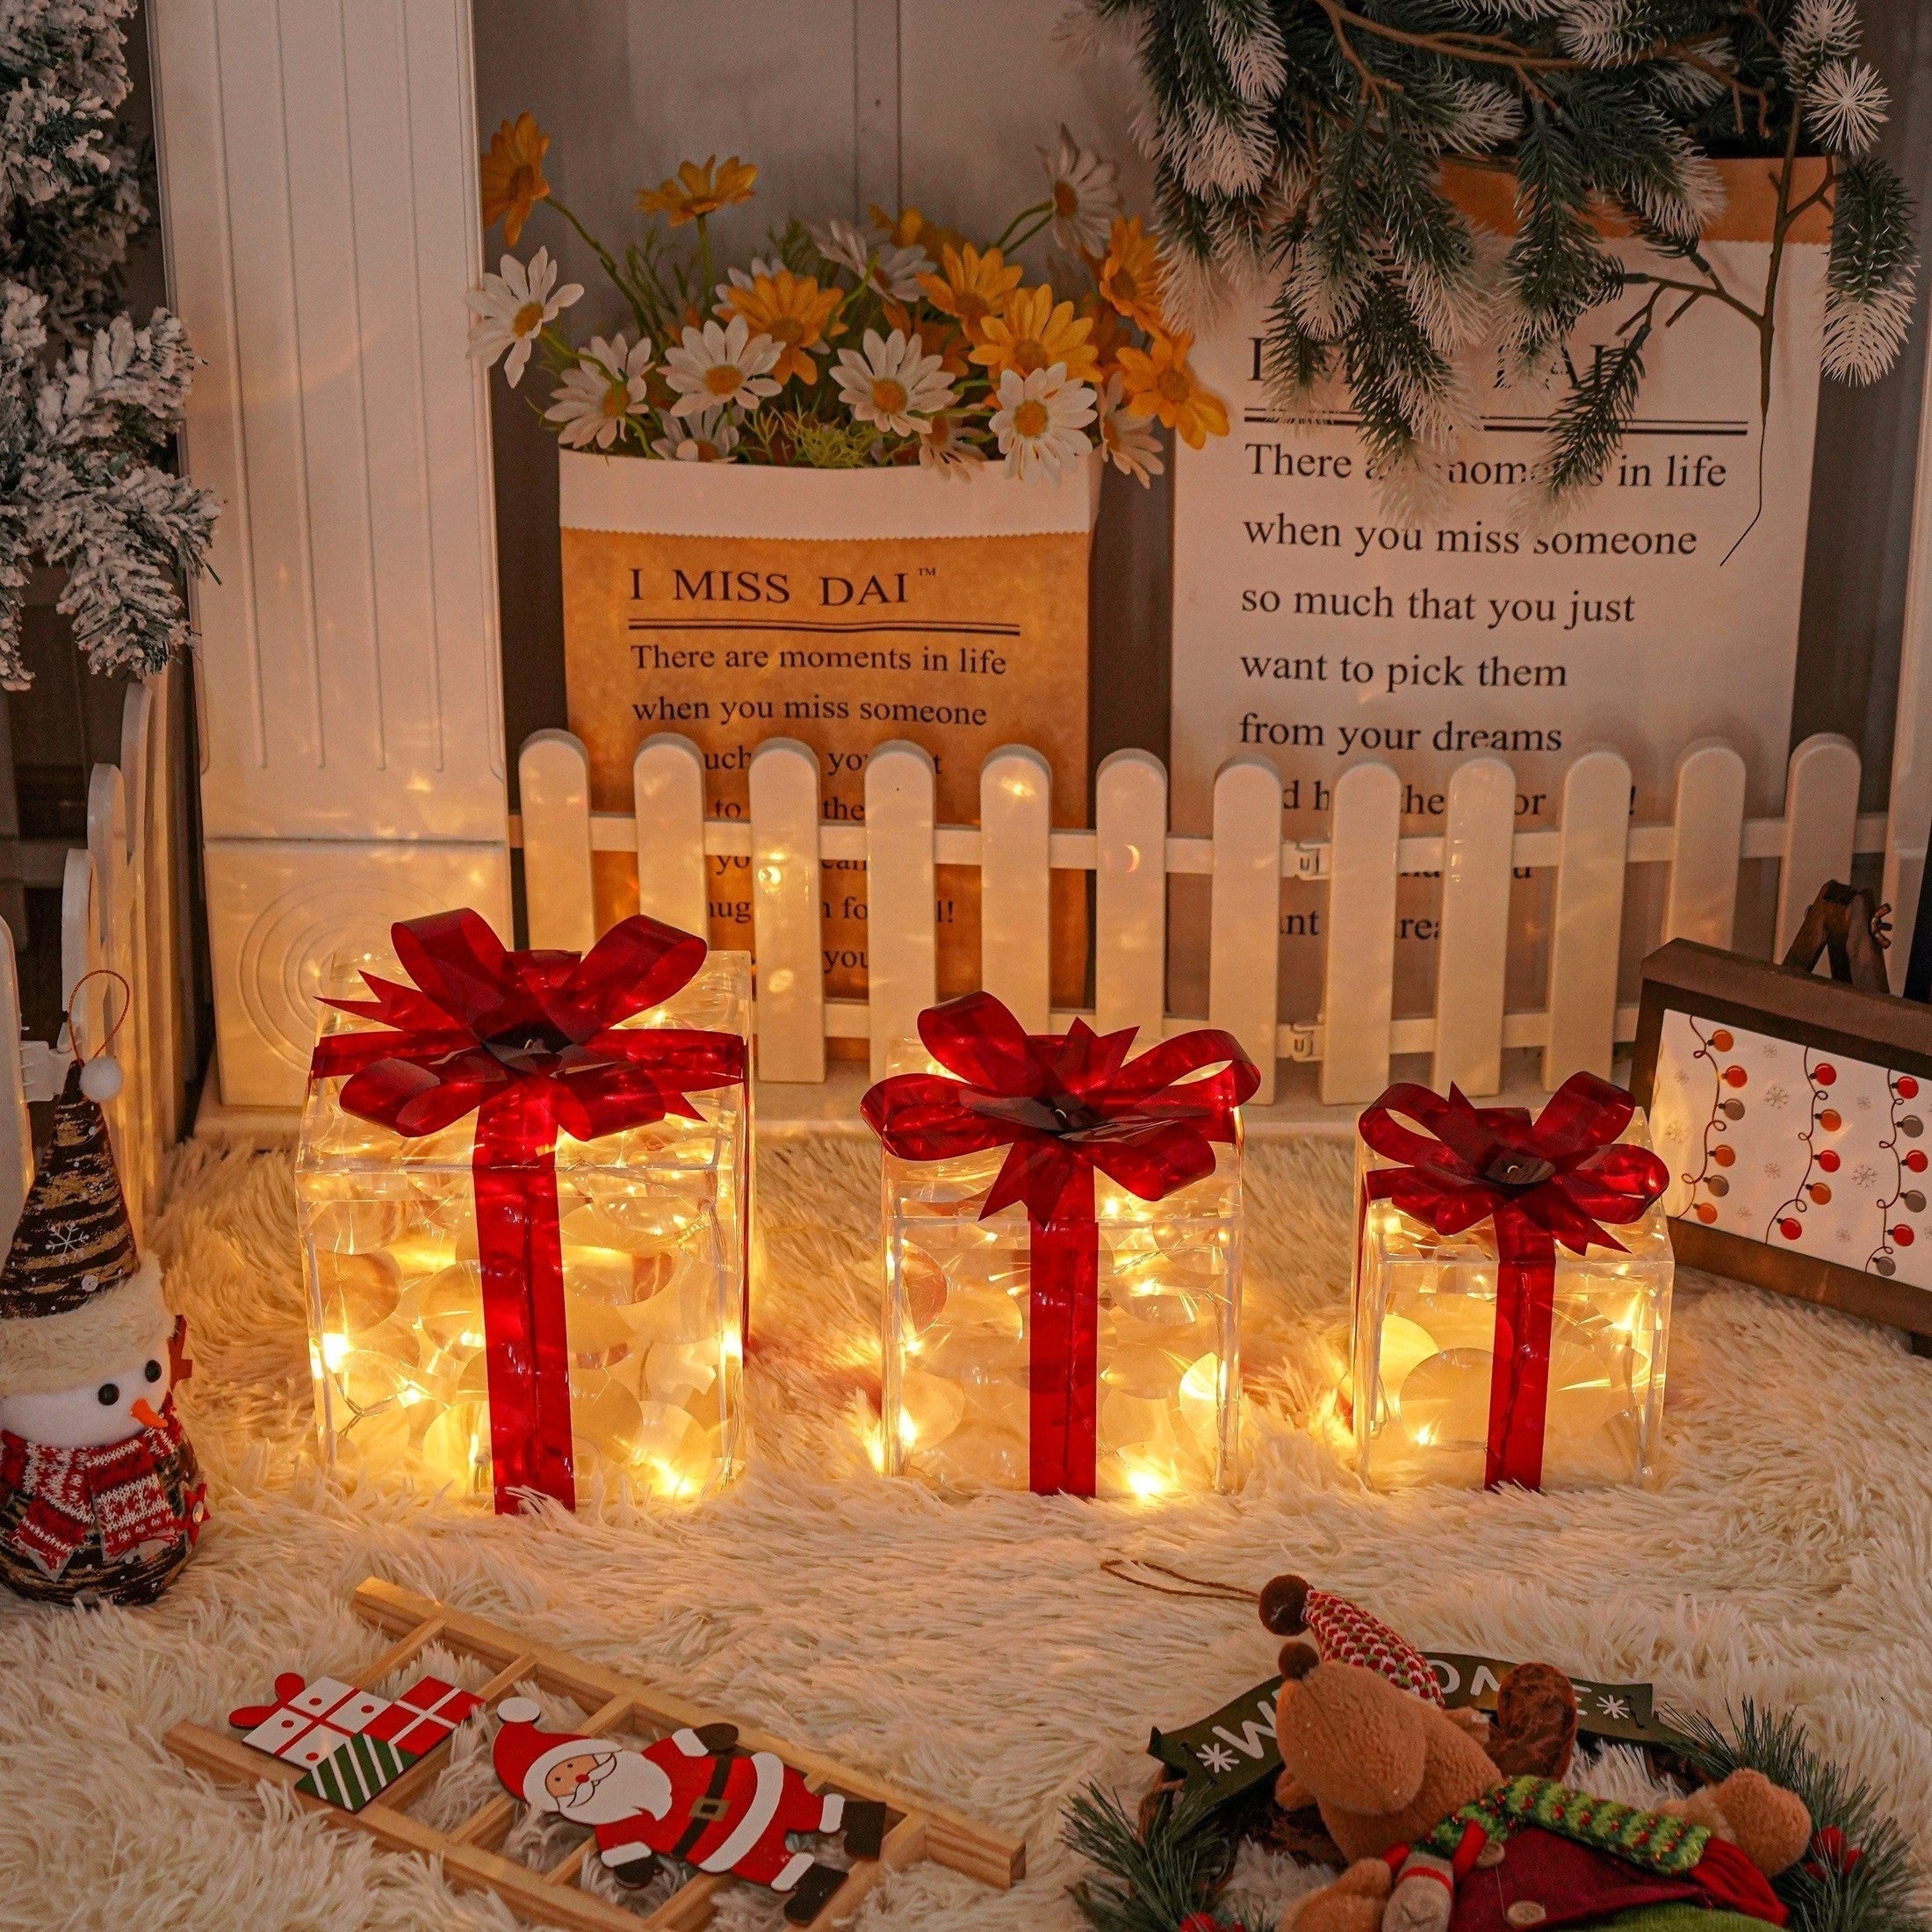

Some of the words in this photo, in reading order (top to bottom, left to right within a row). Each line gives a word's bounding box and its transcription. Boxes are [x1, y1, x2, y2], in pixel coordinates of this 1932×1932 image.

[1244, 443, 1352, 479] There
[1618, 454, 1651, 487] in
[1667, 455, 1727, 487] life
[1244, 514, 1341, 547] when
[1354, 527, 1423, 558] you
[1437, 520, 1519, 554] miss
[1533, 532, 1697, 555] someone
[631, 568, 642, 601] I
[674, 569, 790, 604] MISS
[1242, 589, 1280, 612] so
[1294, 586, 1393, 618] much
[1408, 588, 1476, 621] that
[1487, 599, 1554, 630] you
[1563, 589, 1635, 631] just
[630, 644, 715, 669] There
[725, 651, 768, 668] are
[780, 648, 912, 670] moments
[923, 645, 948, 672] in
[960, 647, 1006, 675] life
[1240, 655, 1327, 681] want
[1341, 656, 1373, 683] to
[1387, 654, 1464, 693] pick
[1477, 656, 1566, 687] them
[632, 696, 710, 721] when
[720, 702, 774, 725] you
[784, 694, 849, 719] miss
[860, 703, 987, 726] someone
[1239, 712, 1323, 746] from
[1337, 726, 1422, 756] your
[1432, 720, 1562, 752] dreams
[704, 745, 751, 770] uch
[715, 798, 741, 818] to
[821, 797, 864, 821] the
